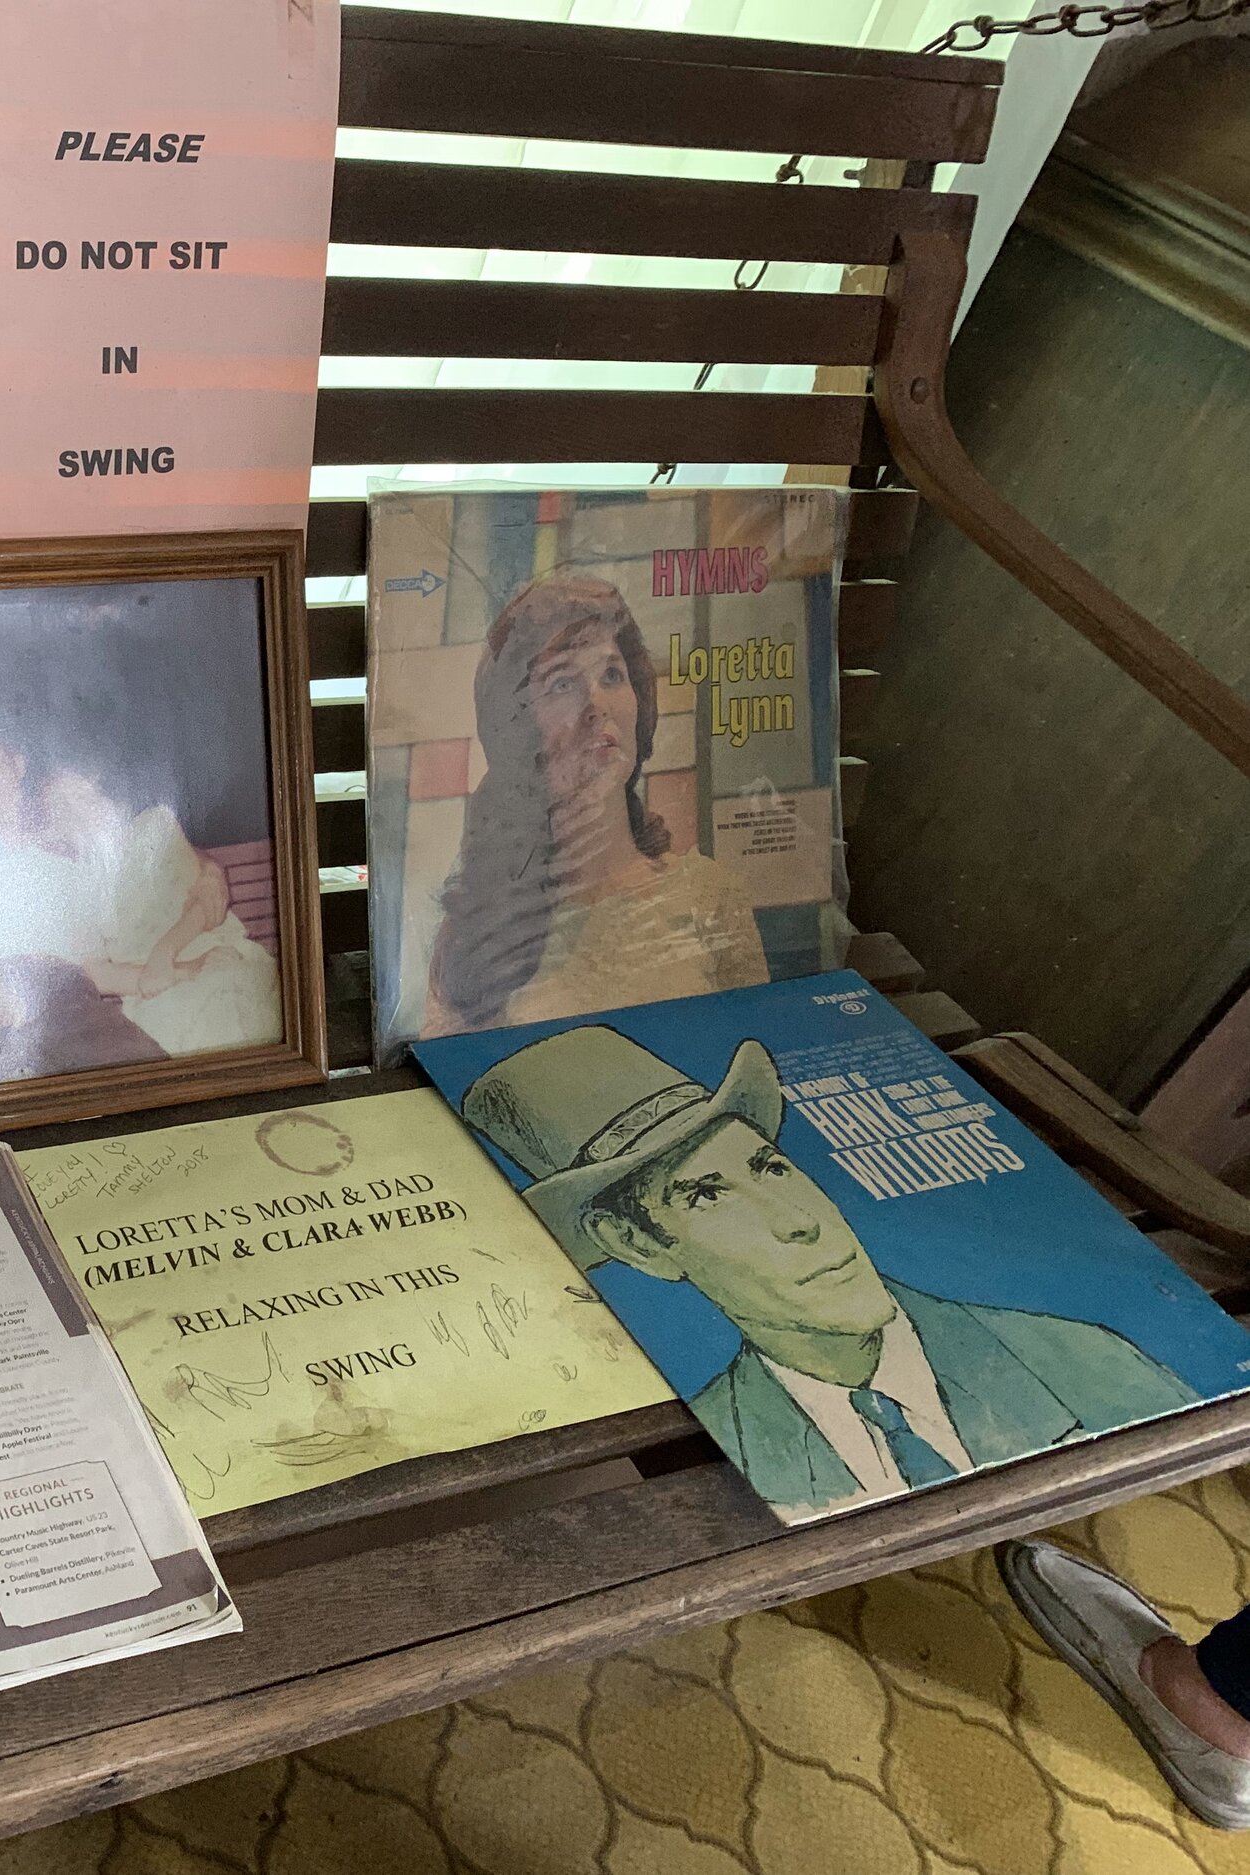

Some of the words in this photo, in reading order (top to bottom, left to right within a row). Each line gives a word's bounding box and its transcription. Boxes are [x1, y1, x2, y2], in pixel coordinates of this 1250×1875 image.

[54, 131, 205, 163] PLEASE
[15, 241, 68, 270] DO
[80, 241, 158, 270] NOT
[168, 241, 228, 270] SIT
[101, 346, 138, 374] IN
[58, 446, 175, 478] SWING
[386, 580, 421, 589] DECCA
[651, 546, 769, 598] HYMNS
[668, 633, 796, 686] Loretta
[710, 683, 796, 748] Lynn
[812, 988, 872, 1005] Diplomat
[793, 1087, 921, 1149] HANK
[176, 1144, 210, 1178] 2018
[827, 1121, 1026, 1201] WILLIAMS
[254, 1190, 336, 1222] MOM
[341, 1186, 367, 1206] &
[366, 1172, 435, 1201] DAD
[83, 1242, 222, 1291] (MELVIN
[231, 1238, 256, 1260] &
[261, 1219, 364, 1254] CLARA
[367, 1199, 468, 1235] WEBB)
[3, 1308, 27, 1317] Center
[171, 1285, 341, 1339] RELAXING
[345, 1279, 385, 1302] IN
[384, 1263, 461, 1294] THIS
[7, 1318, 25, 1327] Opry
[13, 1348, 50, 1361] Paintsville
[304, 1342, 417, 1388] SWING
[1, 1440, 23, 1451] Apple
[23, 1432, 52, 1444] Festival
[23, 1424, 43, 1433] Days
[3, 1478, 69, 1501] REGIONAL
[25, 1527, 49, 1538] Music
[85, 1513, 98, 1523] US
[97, 1511, 109, 1520] 23
[24, 1541, 49, 1552] Caves
[48, 1535, 69, 1546] State
[68, 1528, 95, 1541] Resort
[3, 1559, 25, 1570] Olive
[25, 1555, 40, 1565] Hill
[8, 1569, 42, 1583] Dueling
[40, 1562, 69, 1576] Barrels
[104, 1545, 137, 1559] Pikeville
[14, 1580, 58, 1596] Paramount
[58, 1575, 76, 1586] Arts
[104, 1559, 135, 1574] Ashland
[186, 1603, 198, 1612] 91
